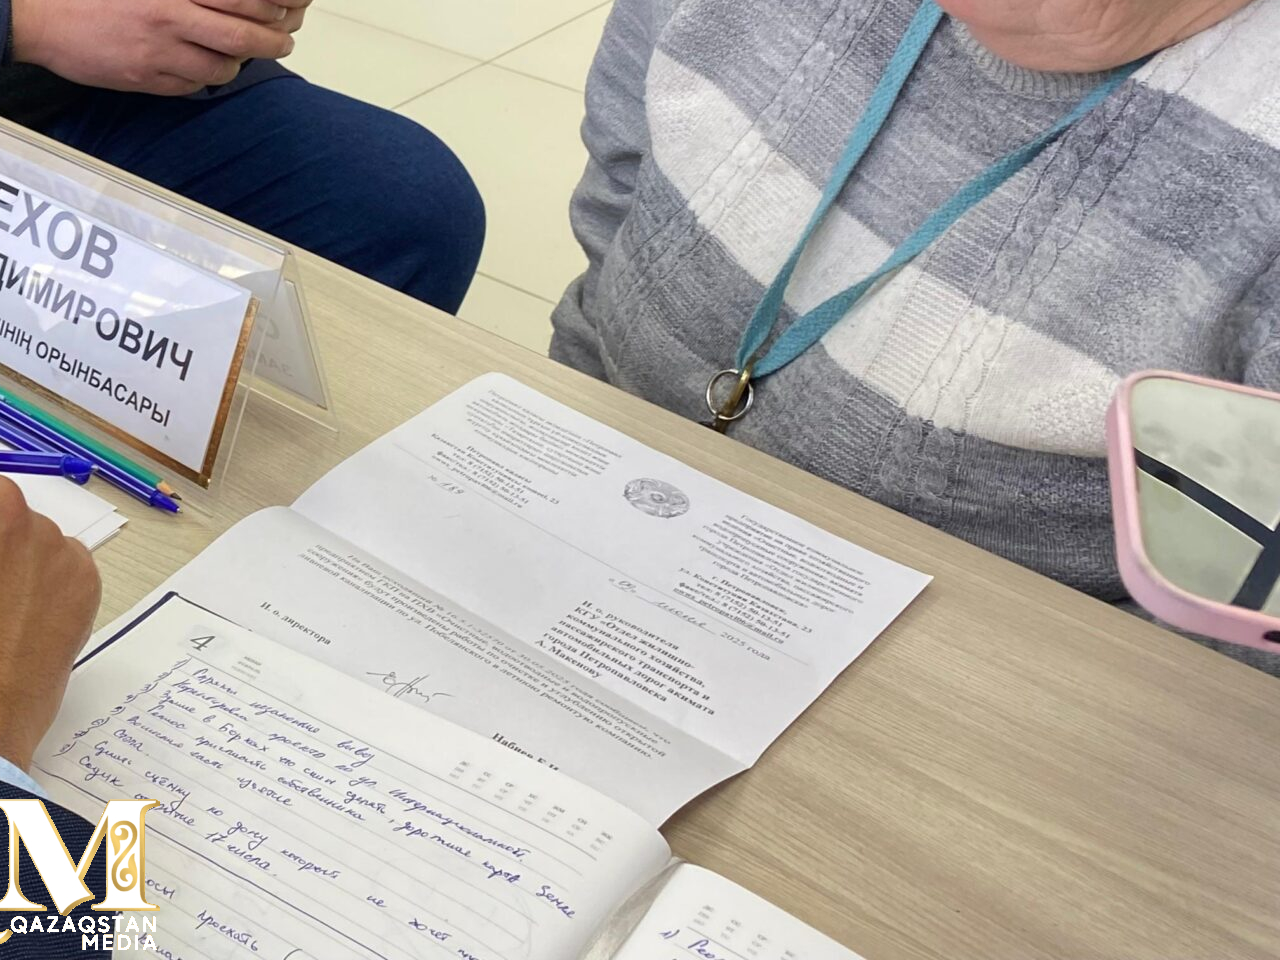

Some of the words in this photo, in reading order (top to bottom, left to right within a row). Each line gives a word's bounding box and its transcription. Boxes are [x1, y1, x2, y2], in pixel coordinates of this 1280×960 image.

[36, 341, 170, 427] ОРЫНБАСАРЫ
[315, 545, 376, 580] предприятием
[377, 579, 400, 592] ГКП
[411, 599, 435, 613] ПХВ
[190, 635, 215, 652] 4
[260, 602, 271, 611] И.
[280, 615, 331, 645] директора
[340, 577, 395, 609] канализации
[500, 669, 540, 692] летнюю
[566, 615, 647, 655] коммунального
[649, 655, 704, 687] хозяйства,
[574, 607, 600, 619] КГУ
[600, 621, 637, 640] «Отдел
[639, 639, 694, 668] жилищно-
[605, 613, 679, 656] руководителя
[720, 632, 746, 646] 2025
[747, 647, 770, 660] года
[364, 580, 391, 596] будут
[391, 596, 450, 631] произведены
[449, 631, 485, 651] работы
[486, 651, 499, 659] по
[501, 660, 540, 683] очистке
[548, 688, 613, 725] углублению
[615, 725, 666, 757] открытой
[543, 633, 577, 657] города
[579, 651, 667, 701] Петропавловска
[549, 646, 601, 678] Макенову
[551, 627, 633, 671] автомобильных
[633, 671, 666, 688] дорог
[667, 688, 714, 715] акимата
[559, 621, 636, 660] пассажирского
[639, 660, 699, 695] транспорта
[203, 715, 216, 724] в
